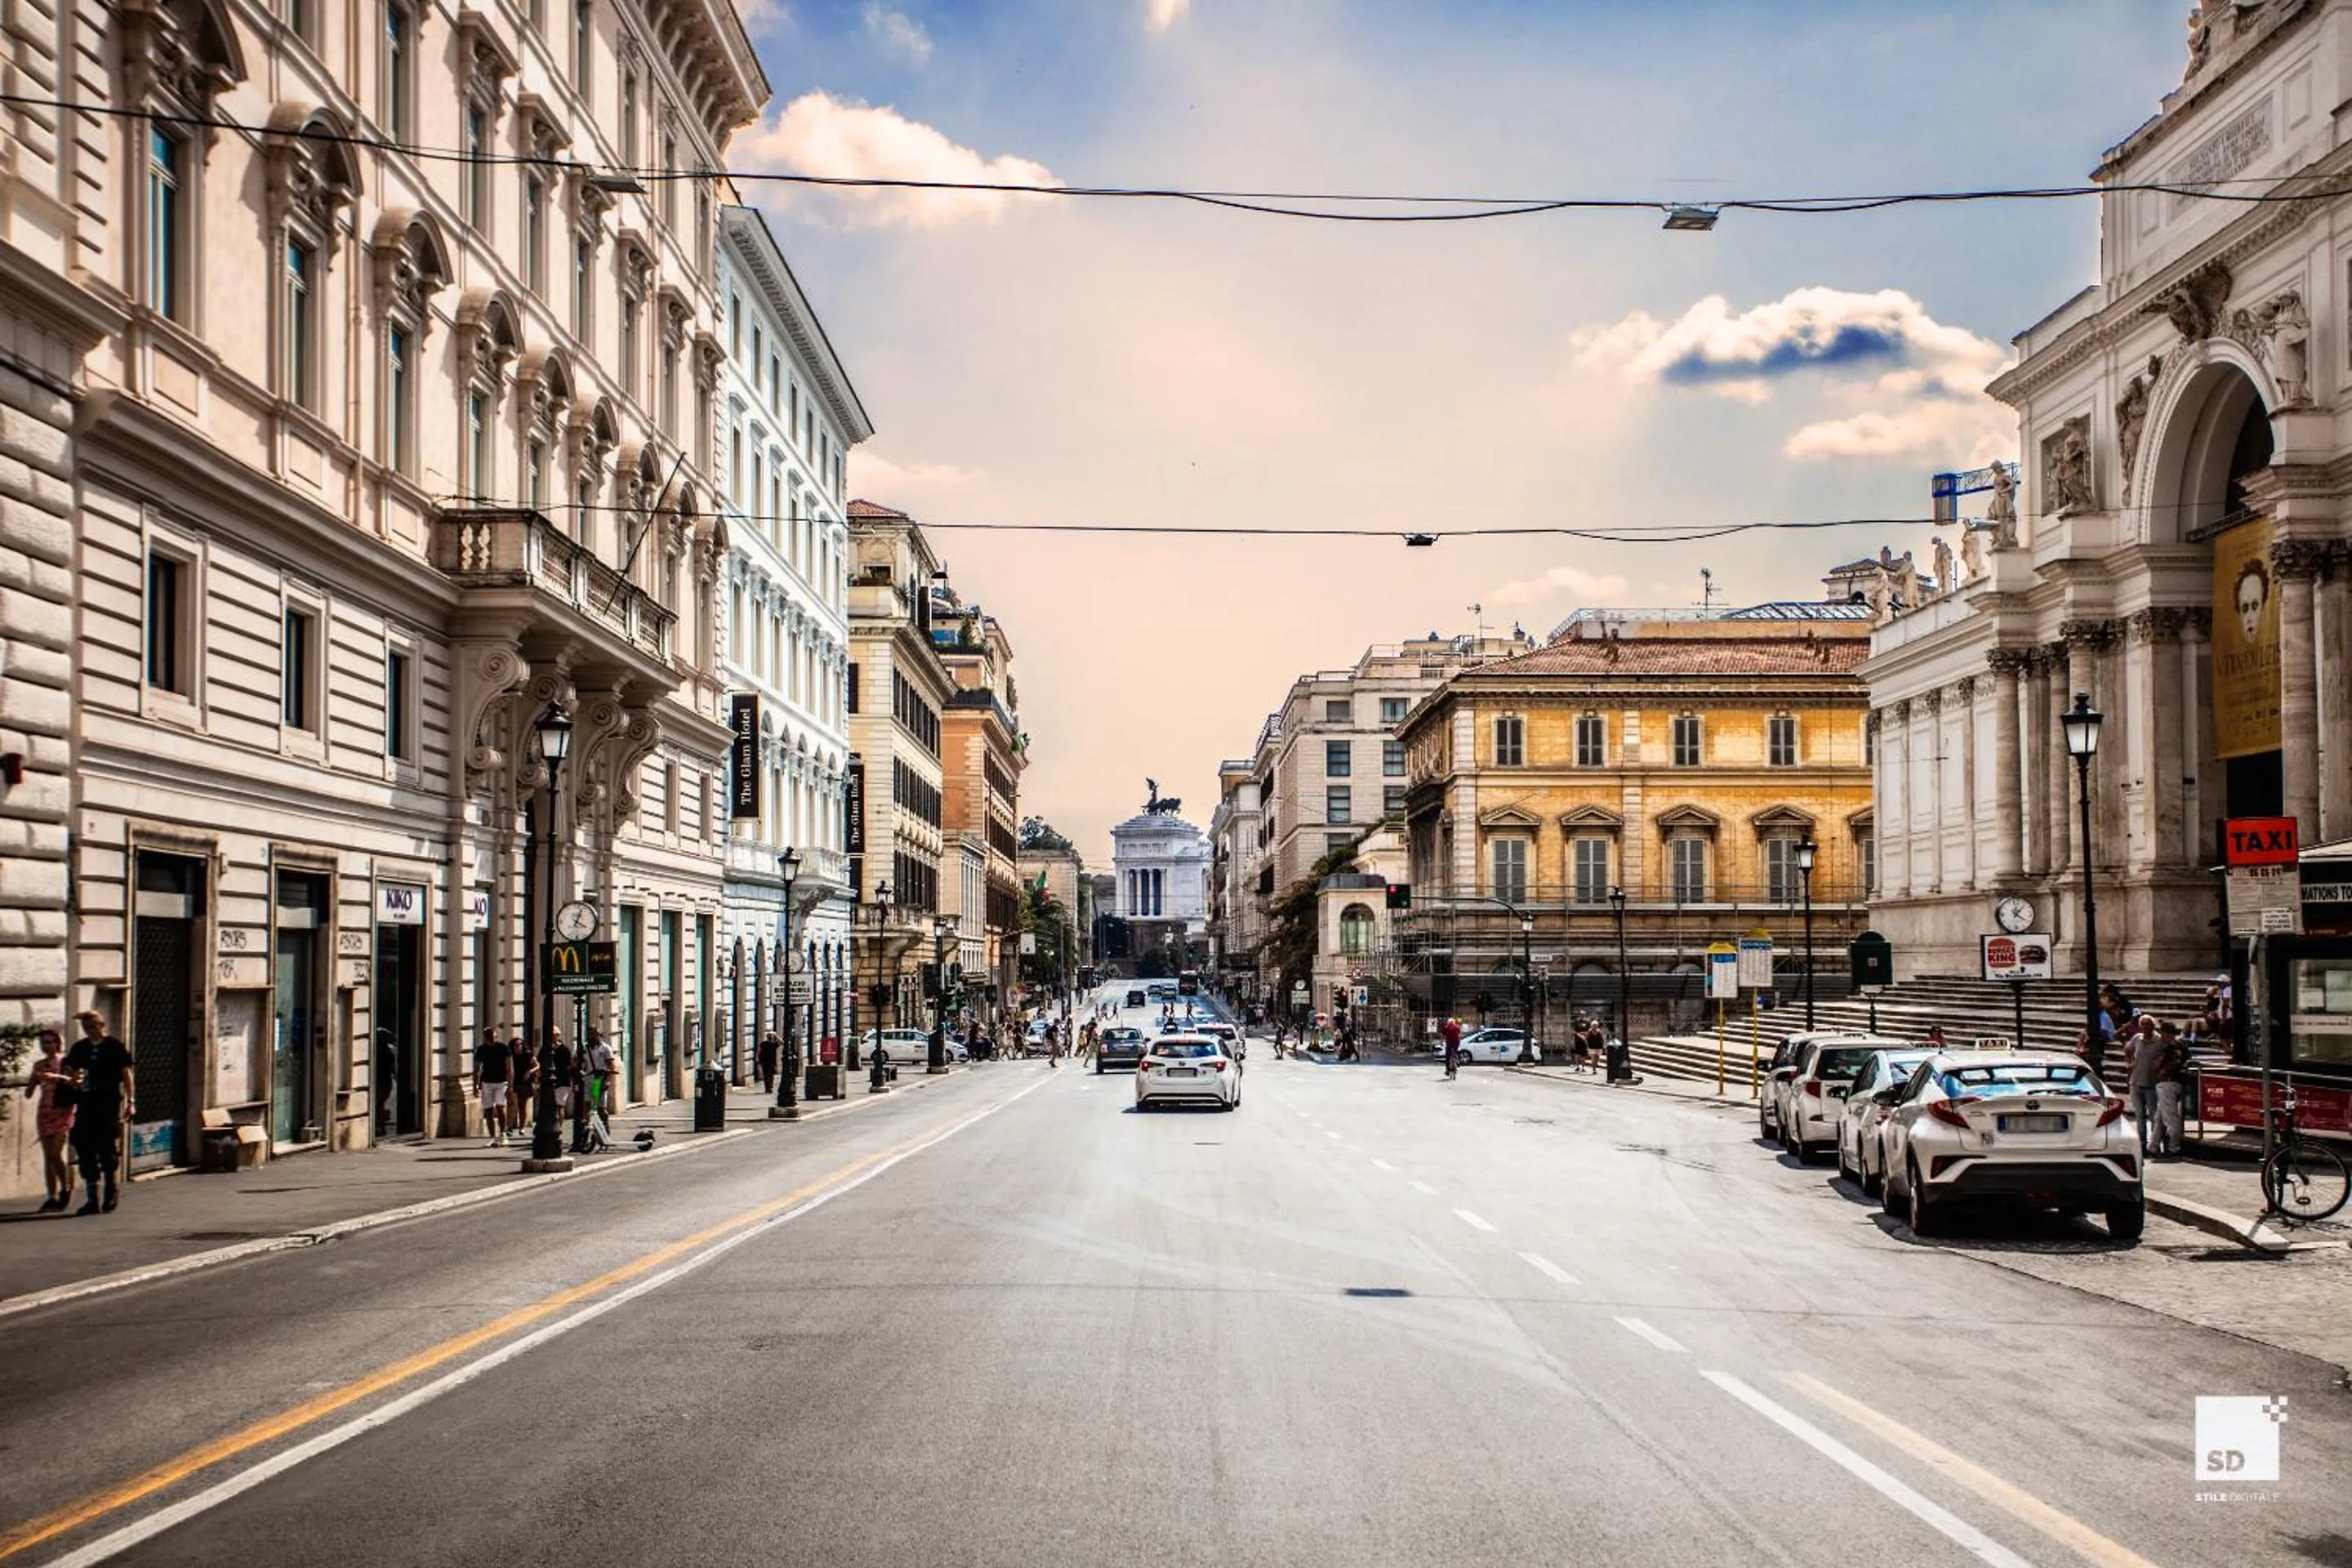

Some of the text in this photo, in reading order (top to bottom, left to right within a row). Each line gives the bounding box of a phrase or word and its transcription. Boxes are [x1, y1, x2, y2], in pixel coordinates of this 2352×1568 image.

[740, 708, 751, 805] The Glam Hotel
[851, 801, 859, 826] Glam
[851, 827, 860, 846] The
[2231, 830, 2293, 853] TAXI
[386, 888, 413, 910] KIKO
[1988, 954, 2016, 962] KING
